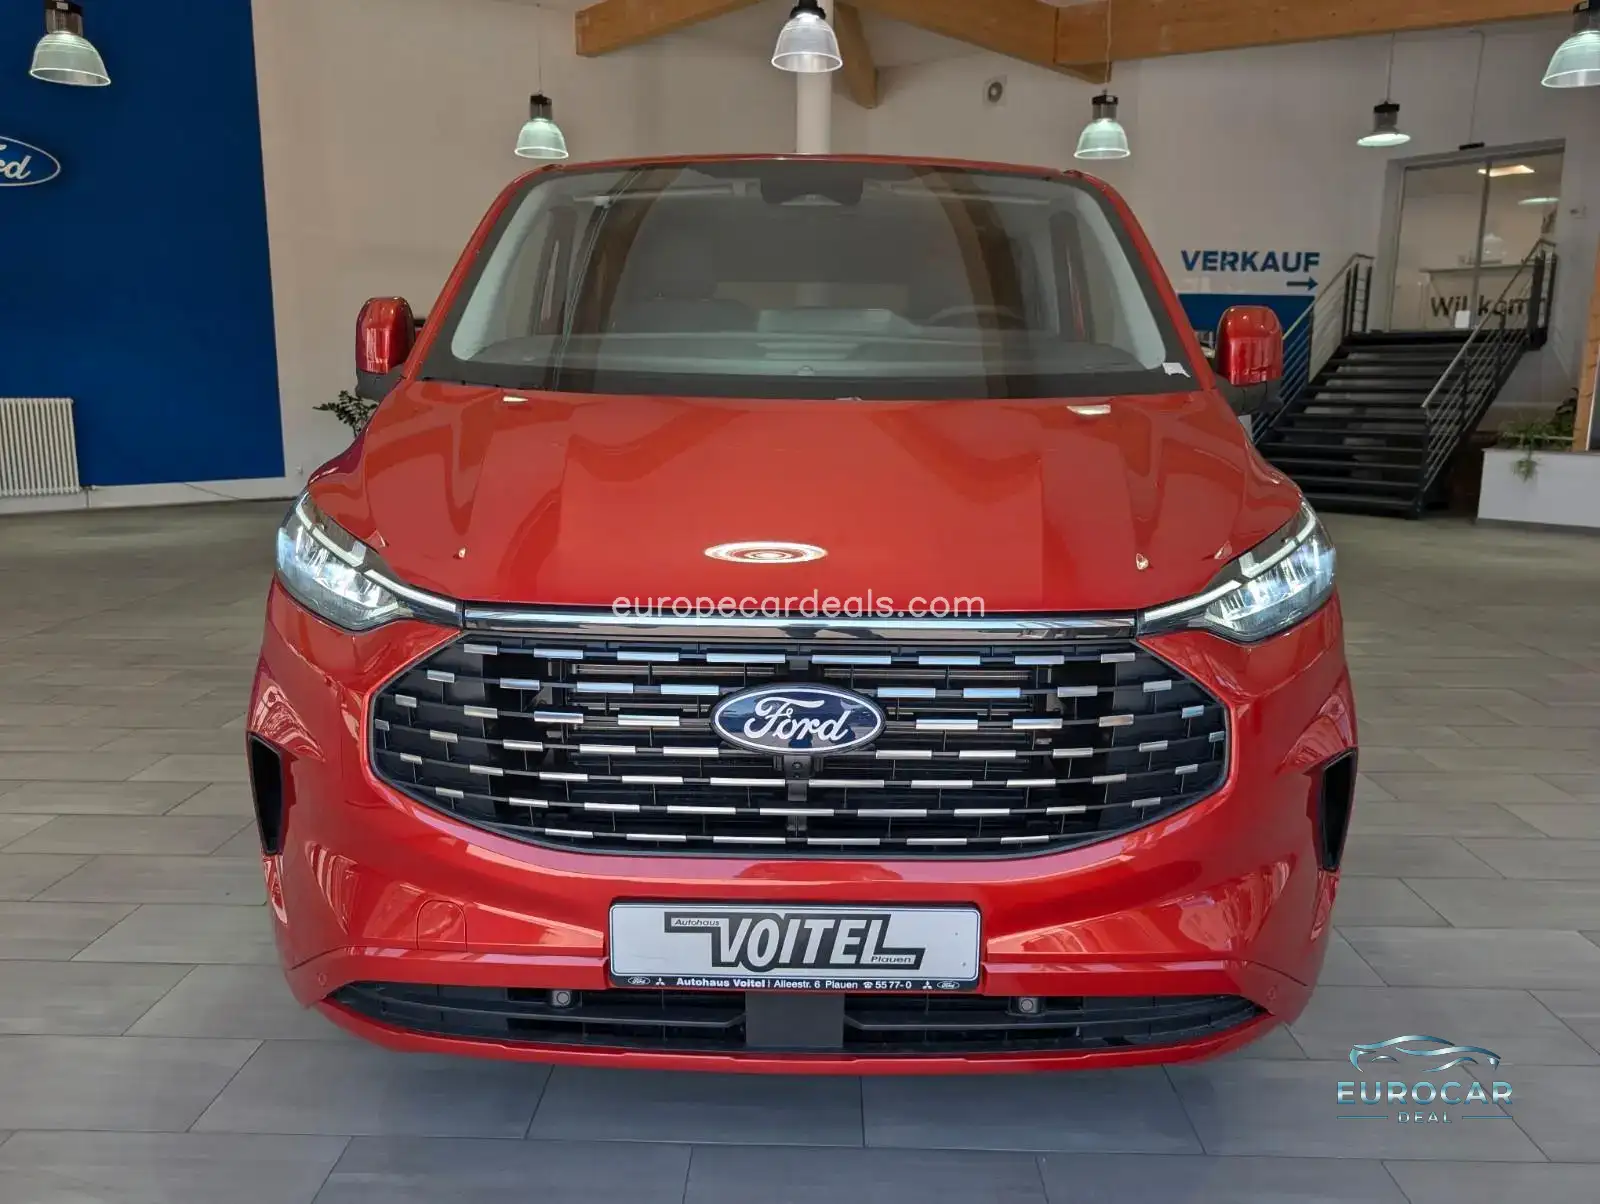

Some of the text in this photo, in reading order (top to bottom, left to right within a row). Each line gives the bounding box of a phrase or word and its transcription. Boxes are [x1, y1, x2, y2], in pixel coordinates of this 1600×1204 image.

[1181, 250, 1320, 273] VERKAUF
[743, 696, 851, 742] Ford
[674, 918, 720, 927] Autohaus
[719, 918, 883, 967] VOITEL
[870, 955, 912, 963] Plauen
[676, 977, 730, 987] Autohaus
[733, 979, 765, 988] Voitel
[773, 980, 812, 988] Alleestr.
[814, 980, 821, 988] 6
[825, 981, 858, 989] Plauen
